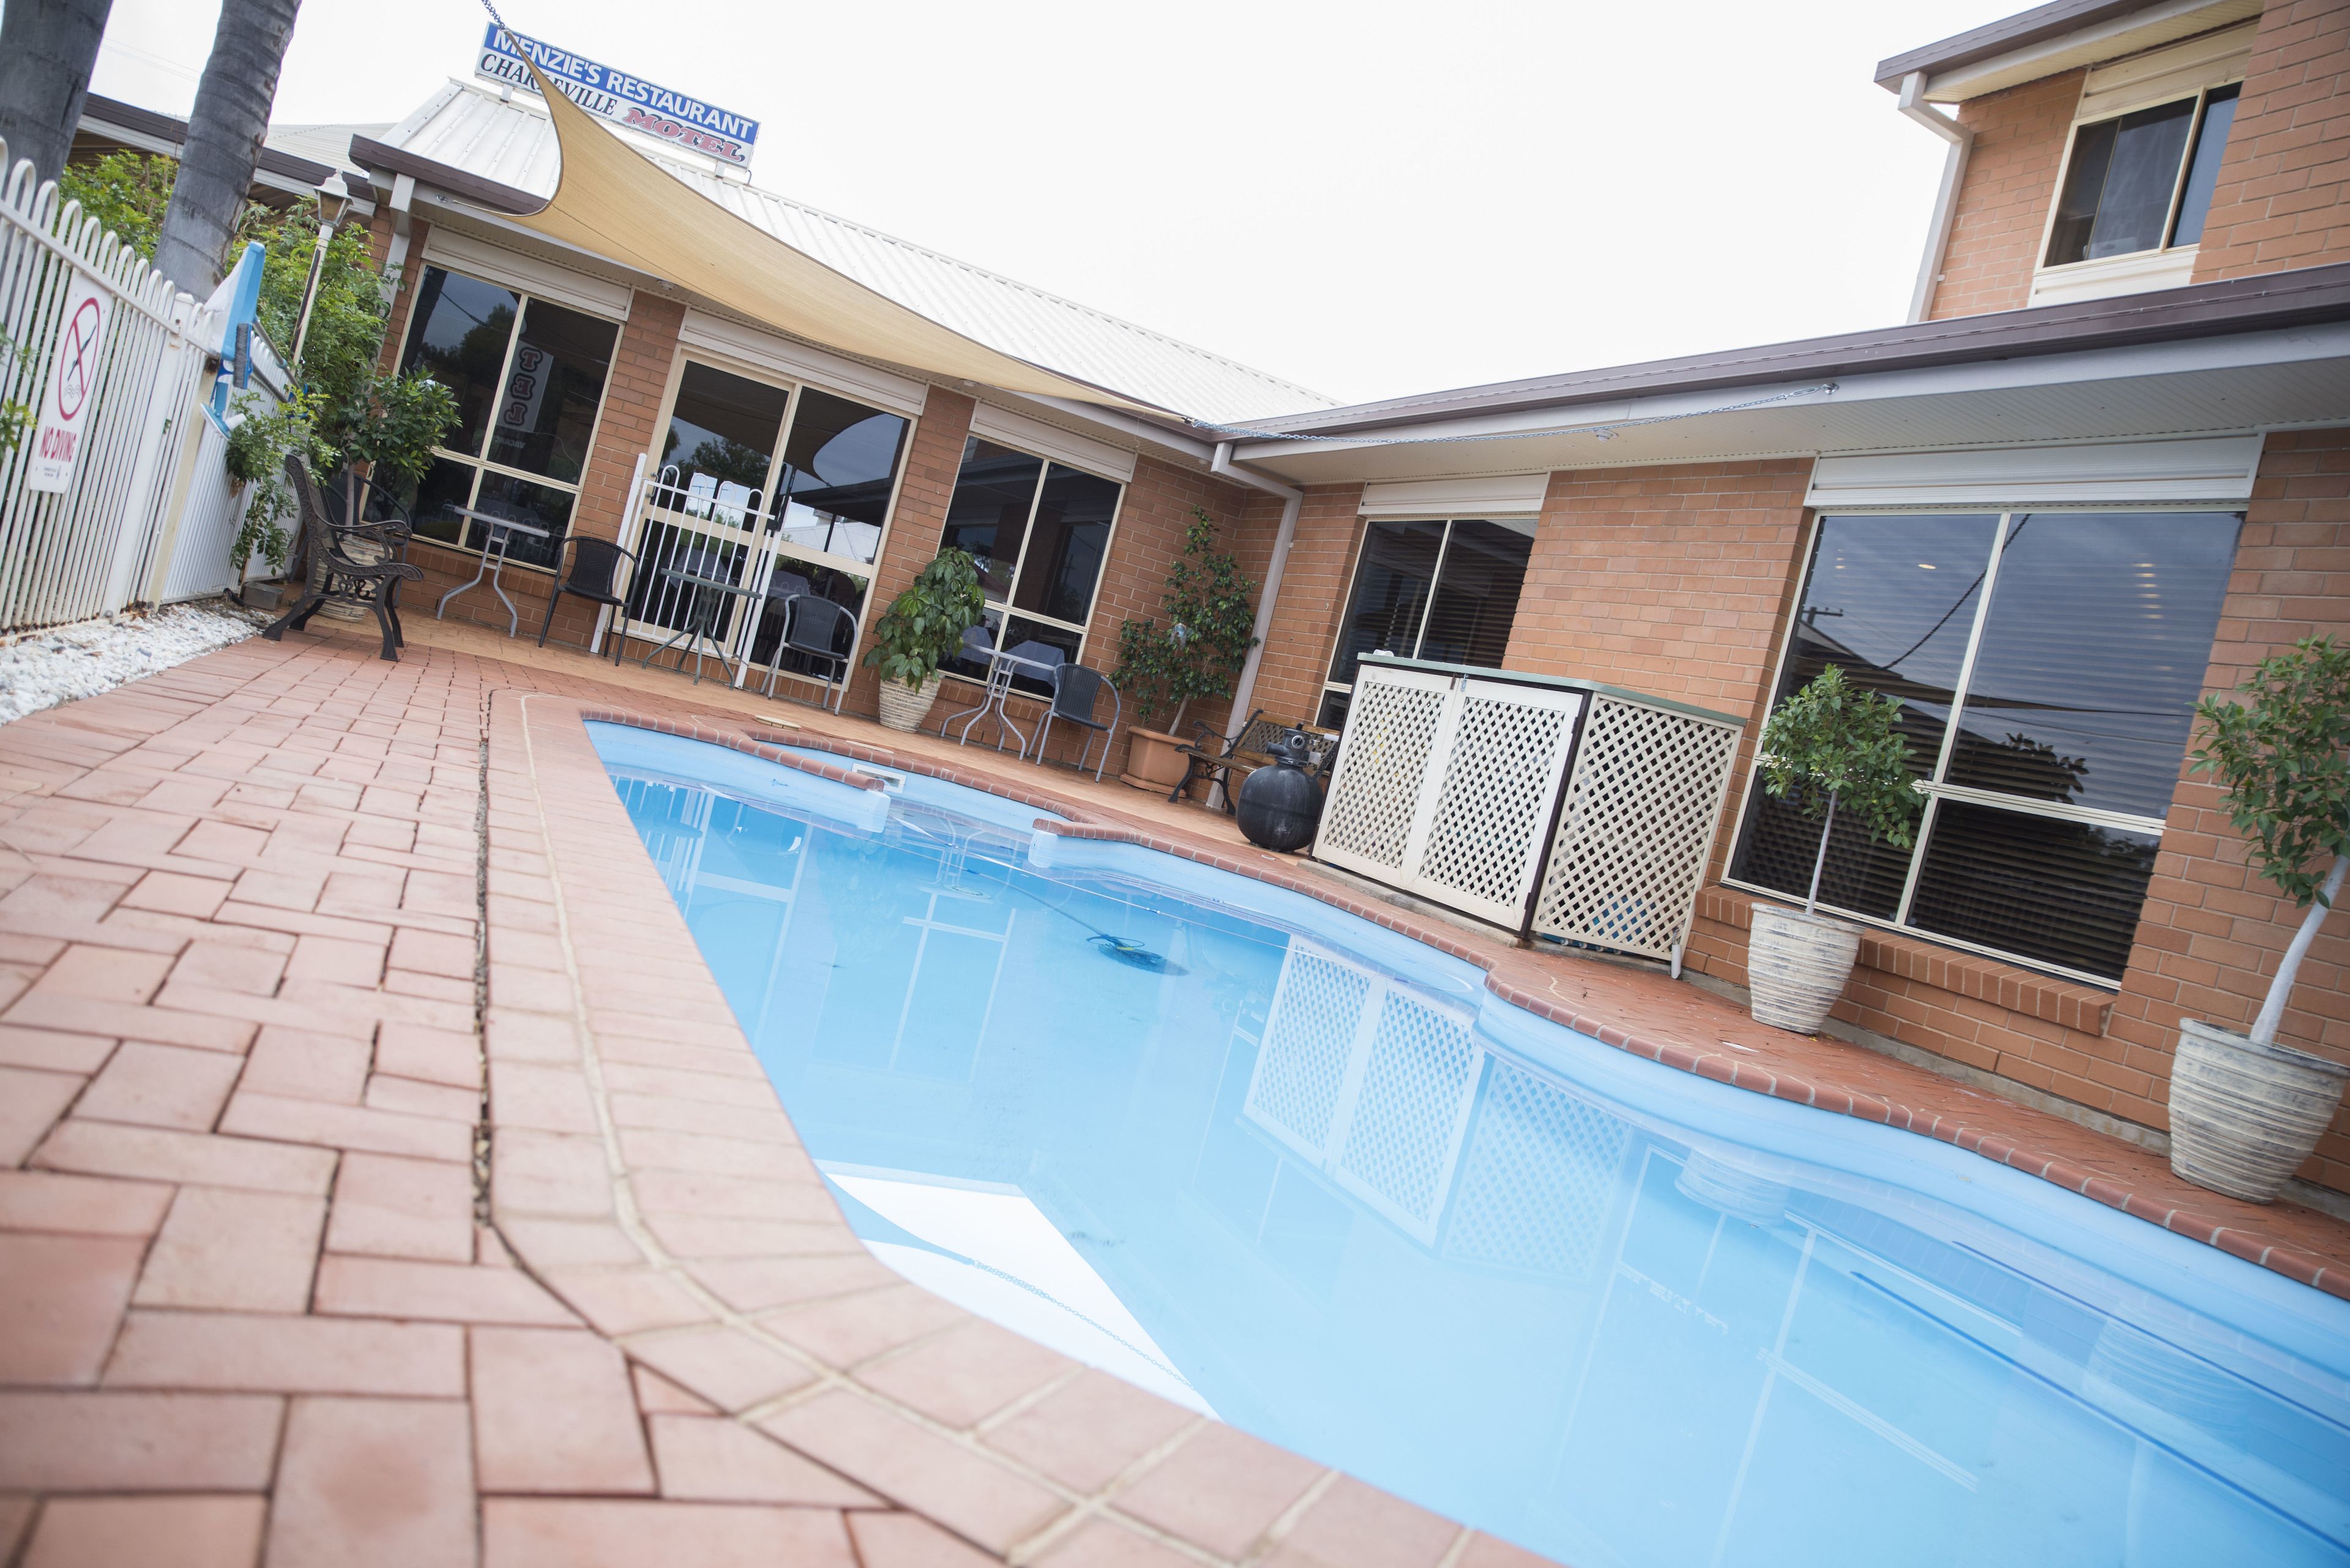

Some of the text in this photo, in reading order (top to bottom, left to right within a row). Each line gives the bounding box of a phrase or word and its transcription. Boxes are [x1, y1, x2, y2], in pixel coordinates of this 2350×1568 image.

[493, 29, 754, 139] MENZIE'S RESTAURANT
[622, 107, 745, 163] MOTEL
[39, 426, 76, 463] NO DIVING
